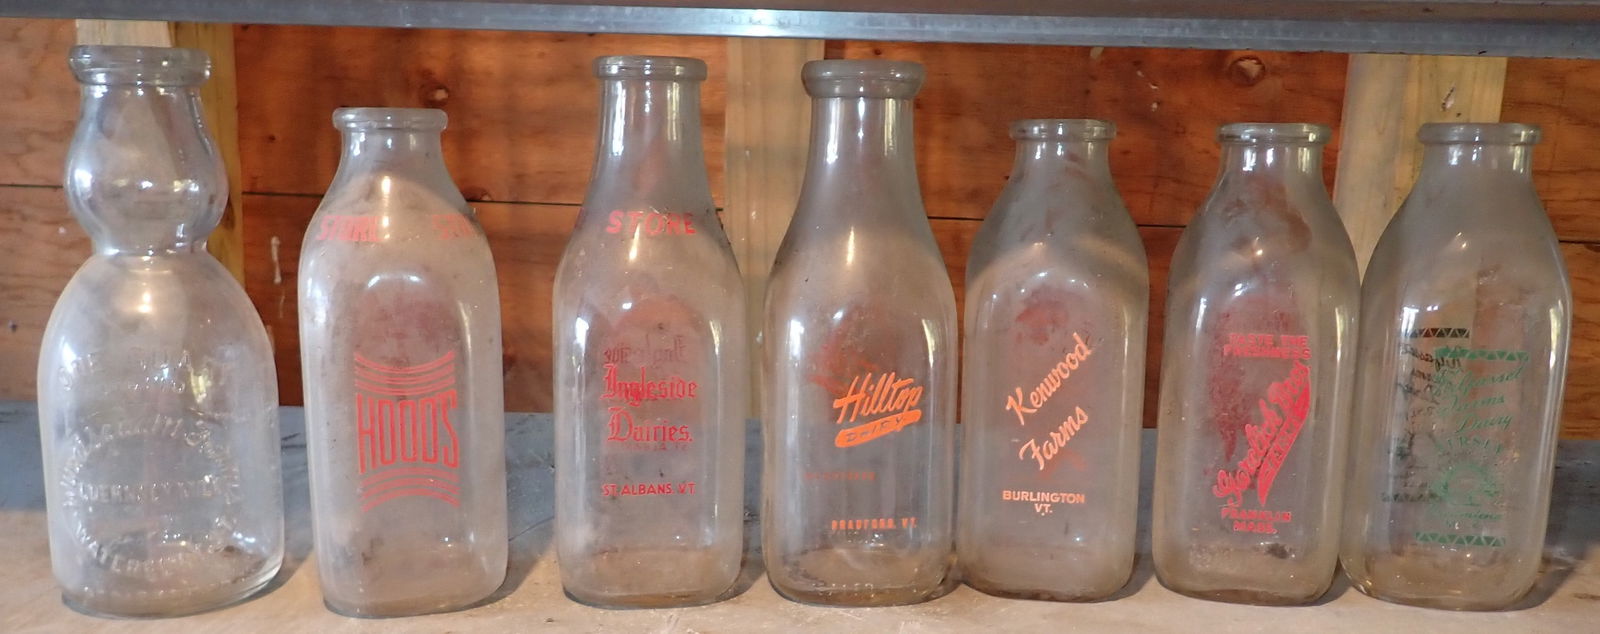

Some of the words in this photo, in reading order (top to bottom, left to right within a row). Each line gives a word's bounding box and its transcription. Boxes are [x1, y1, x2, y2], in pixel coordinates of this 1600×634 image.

[606, 210, 696, 234] STORE
[601, 363, 698, 407] Ingleside
[833, 372, 923, 424] Hilltop
[1006, 332, 1092, 426] Kenwood
[1019, 406, 1089, 471] Farms
[1002, 490, 1085, 504] BURLINGTON
[1034, 503, 1053, 513] VT.
